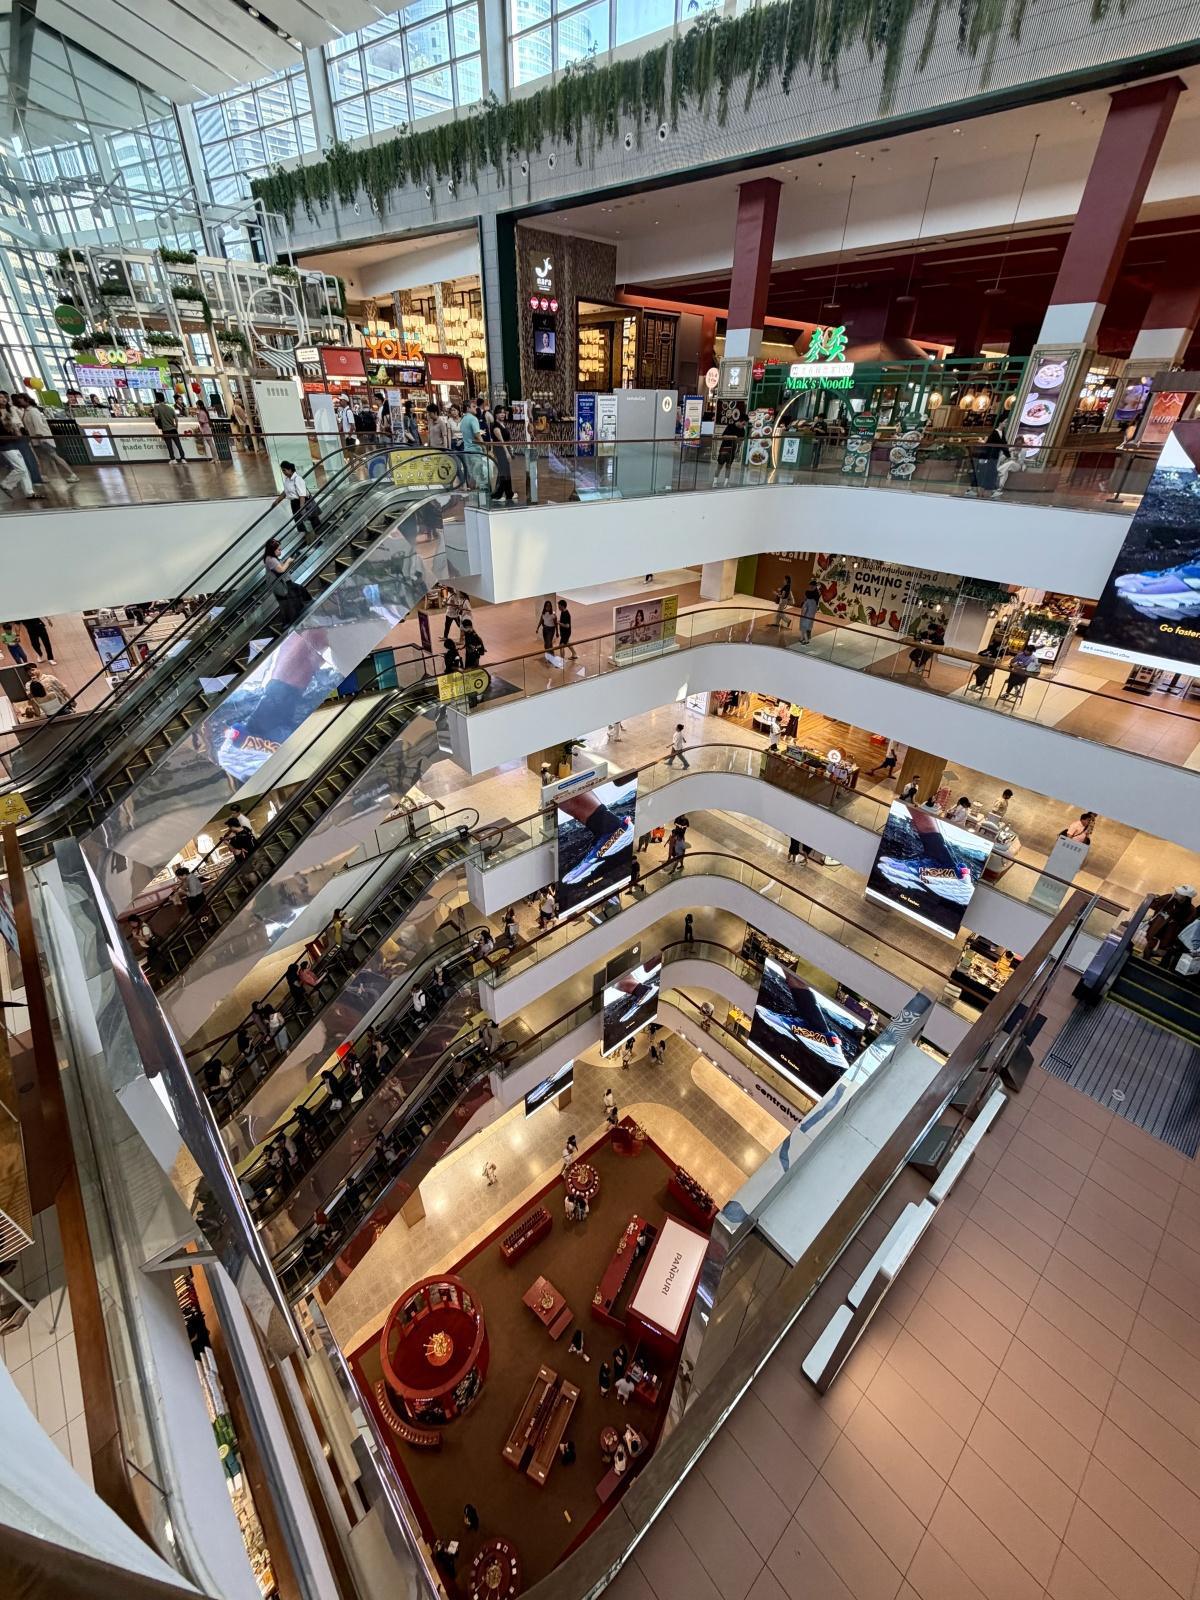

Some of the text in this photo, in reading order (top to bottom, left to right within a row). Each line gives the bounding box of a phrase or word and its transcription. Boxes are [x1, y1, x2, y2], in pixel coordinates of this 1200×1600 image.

[95, 348, 143, 366] BOOST
[365, 336, 424, 361] YOLK
[785, 376, 856, 390] Mak's Noodle
[855, 571, 903, 589] COMING
[852, 583, 881, 598] MAY
[1159, 623, 1173, 633] Go
[661, 1252, 683, 1296] PAÑPURI
